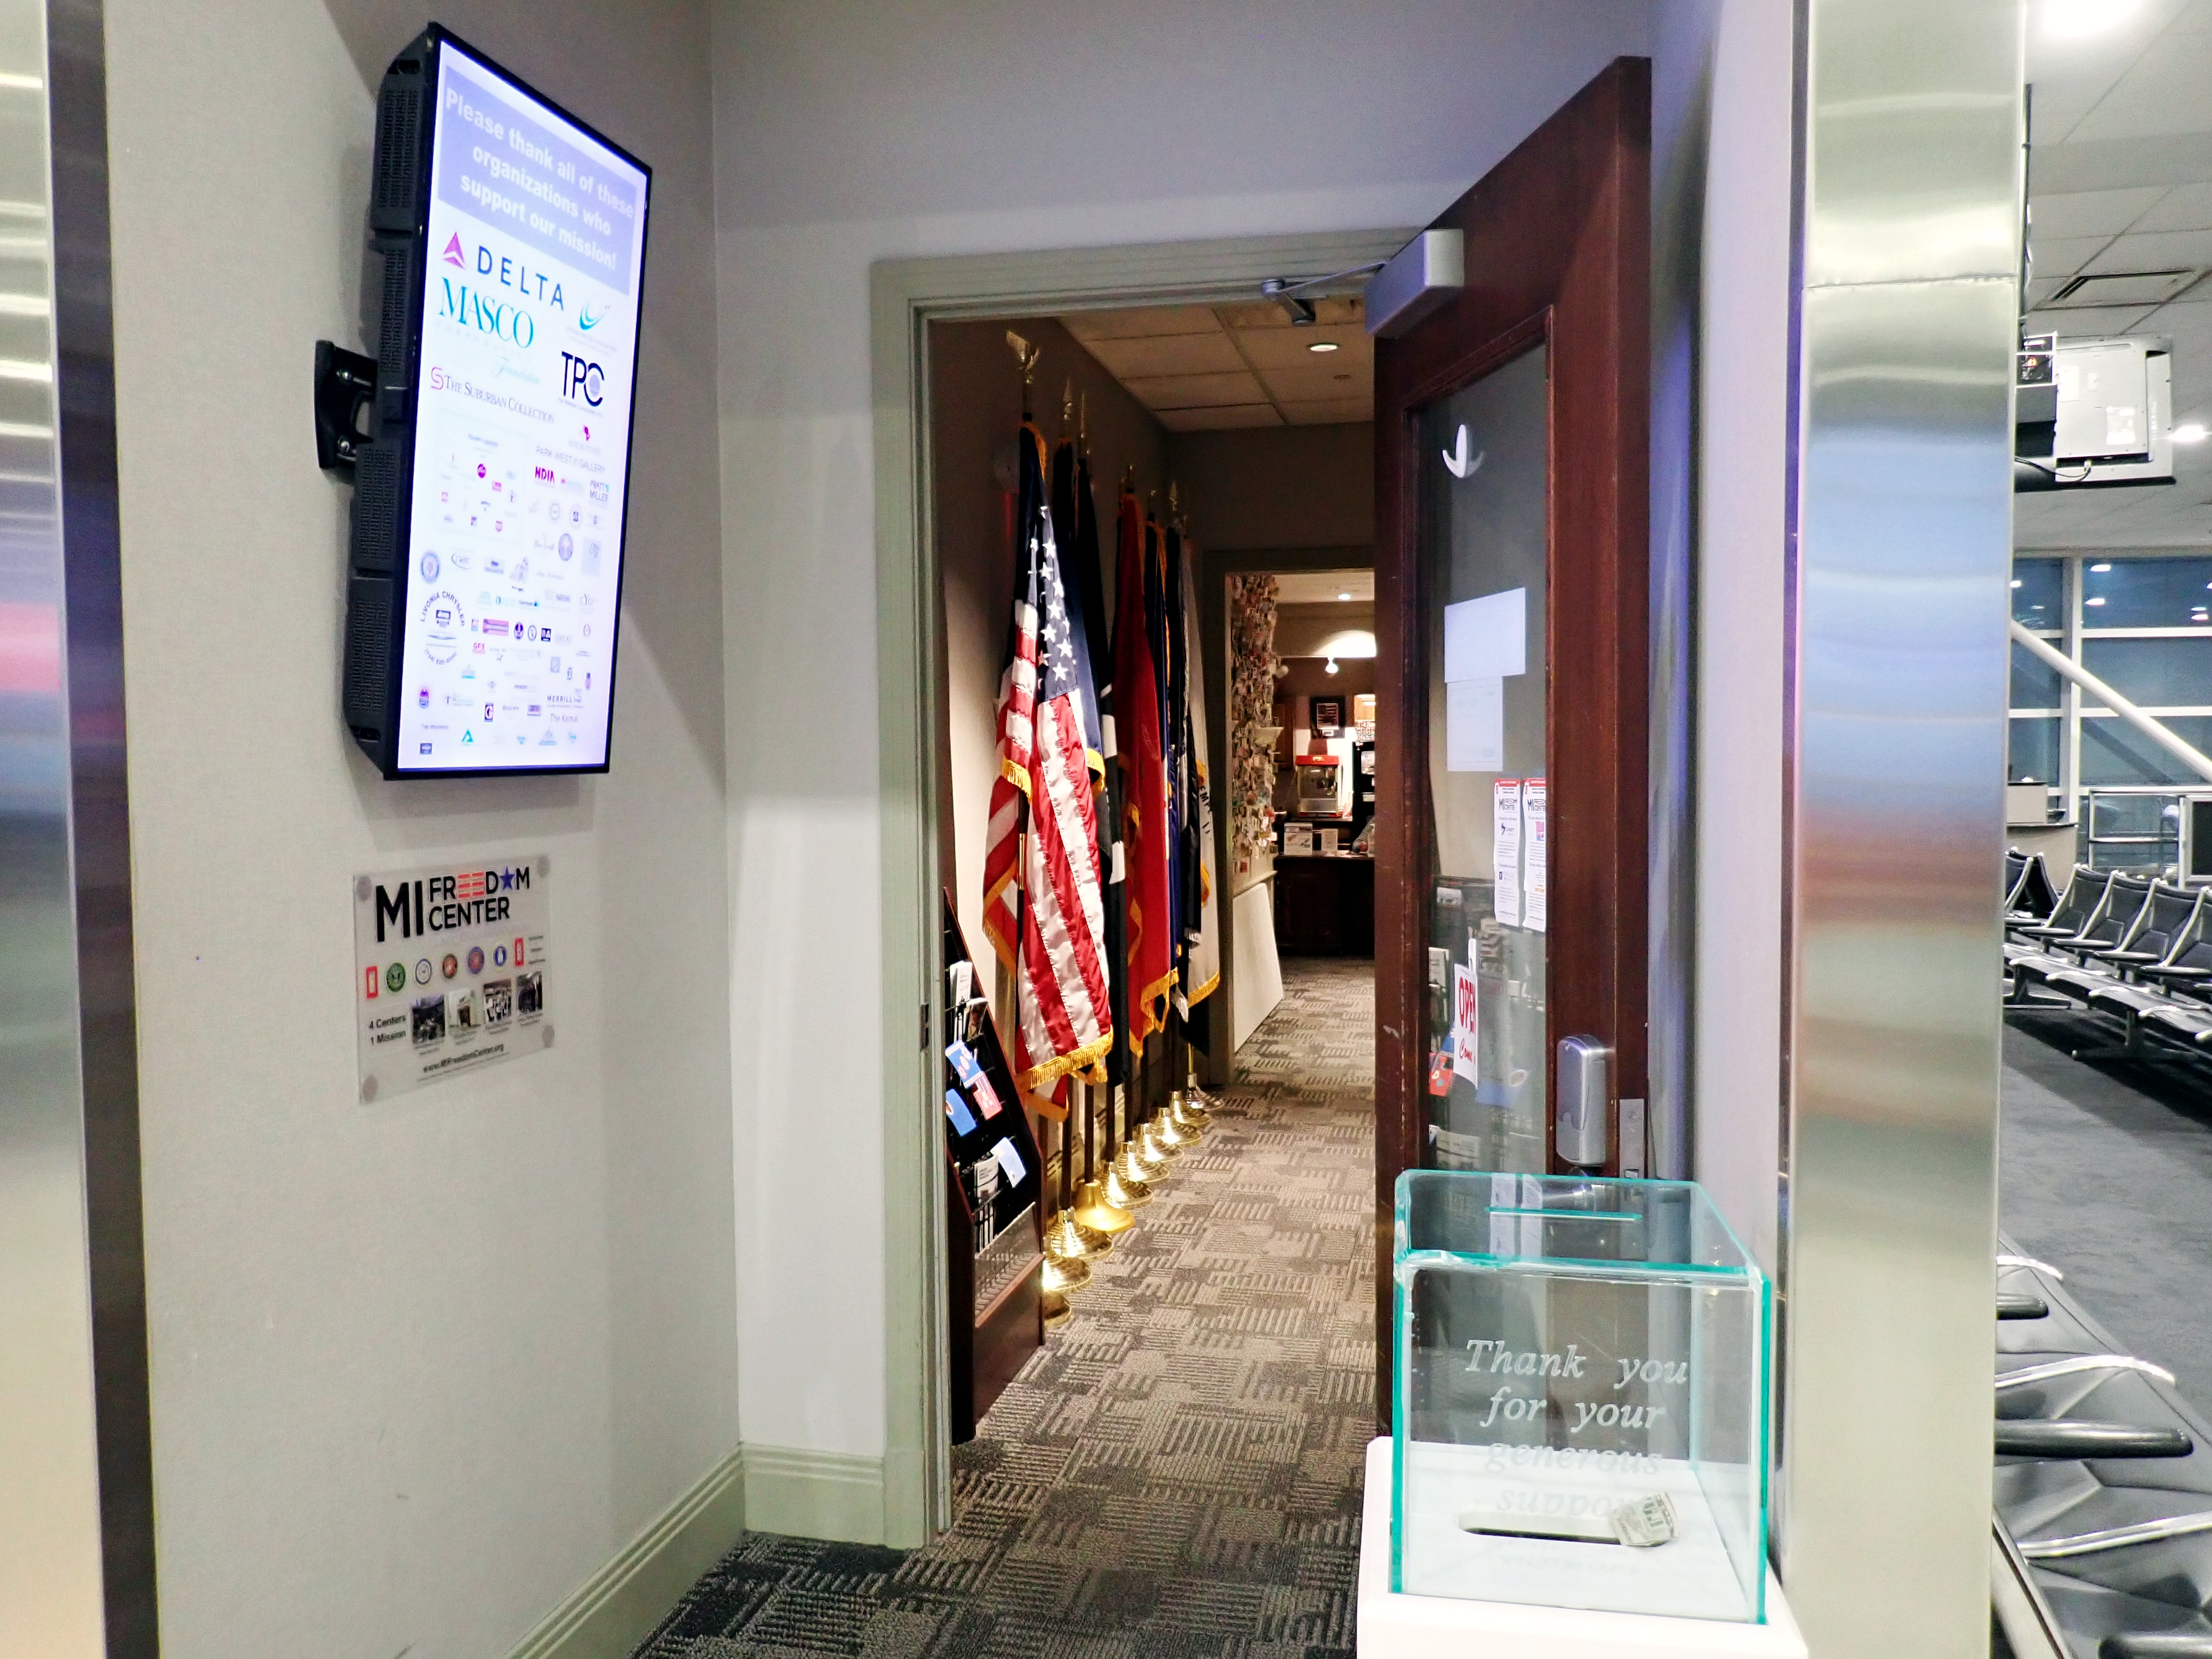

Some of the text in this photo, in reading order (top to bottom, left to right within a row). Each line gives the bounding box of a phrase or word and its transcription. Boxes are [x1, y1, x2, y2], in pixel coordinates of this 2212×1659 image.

[446, 87, 634, 218] Please thank all of these
[473, 146, 611, 236] organizations who
[461, 175, 616, 269] support our mission!
[477, 246, 564, 311] DELTA
[439, 277, 533, 348] MASCO
[561, 351, 604, 407] TPC
[509, 397, 555, 424] COLLECTION
[550, 713, 560, 722] The
[375, 880, 424, 942] MI
[429, 896, 510, 931] CENTER
[1465, 1339, 1689, 1390] Thank you
[1480, 1386, 1666, 1433] for your
[1485, 1442, 1662, 1475] generous
